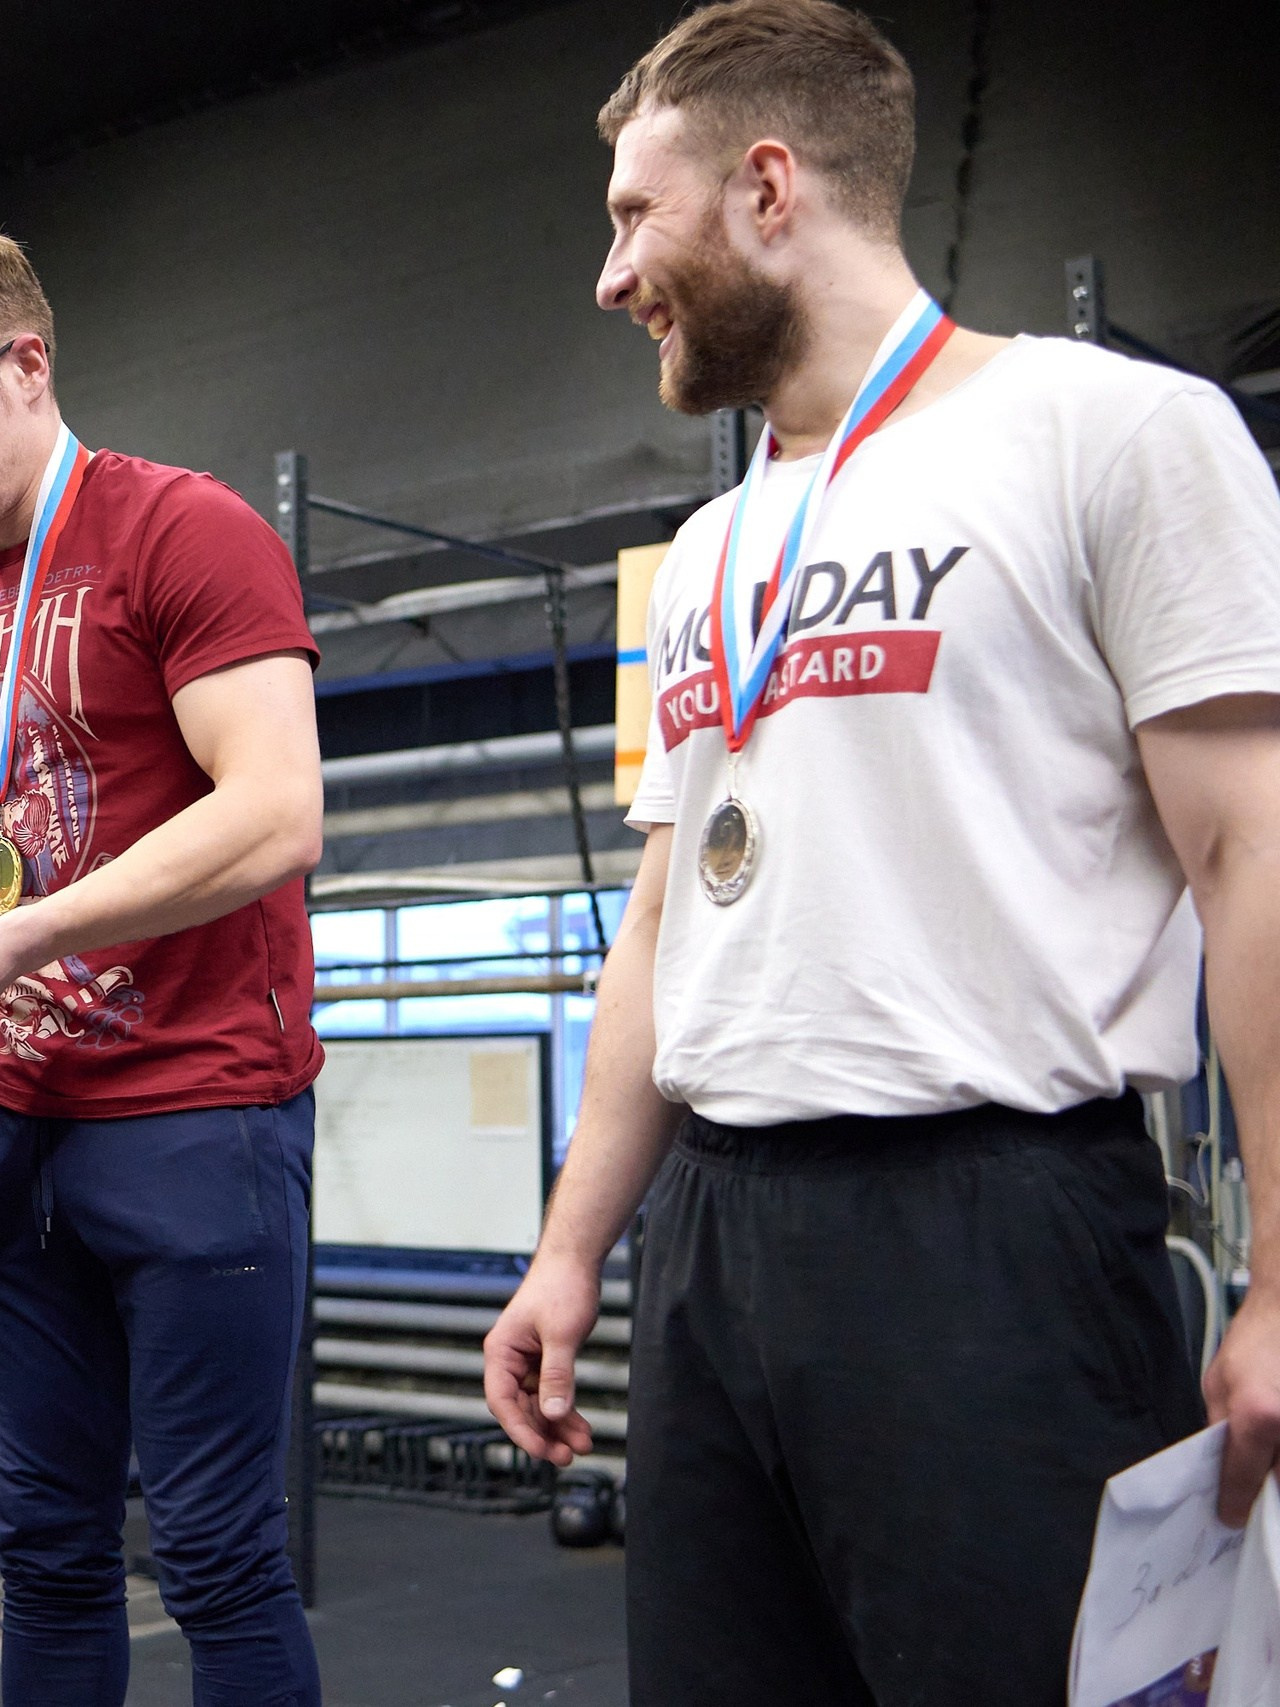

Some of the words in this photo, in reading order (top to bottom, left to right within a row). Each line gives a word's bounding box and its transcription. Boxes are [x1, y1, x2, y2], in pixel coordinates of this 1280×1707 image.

[44, 564, 102, 586] OETRY.
[665, 681, 721, 730] YOU
[762, 644, 886, 706] ASTARD
